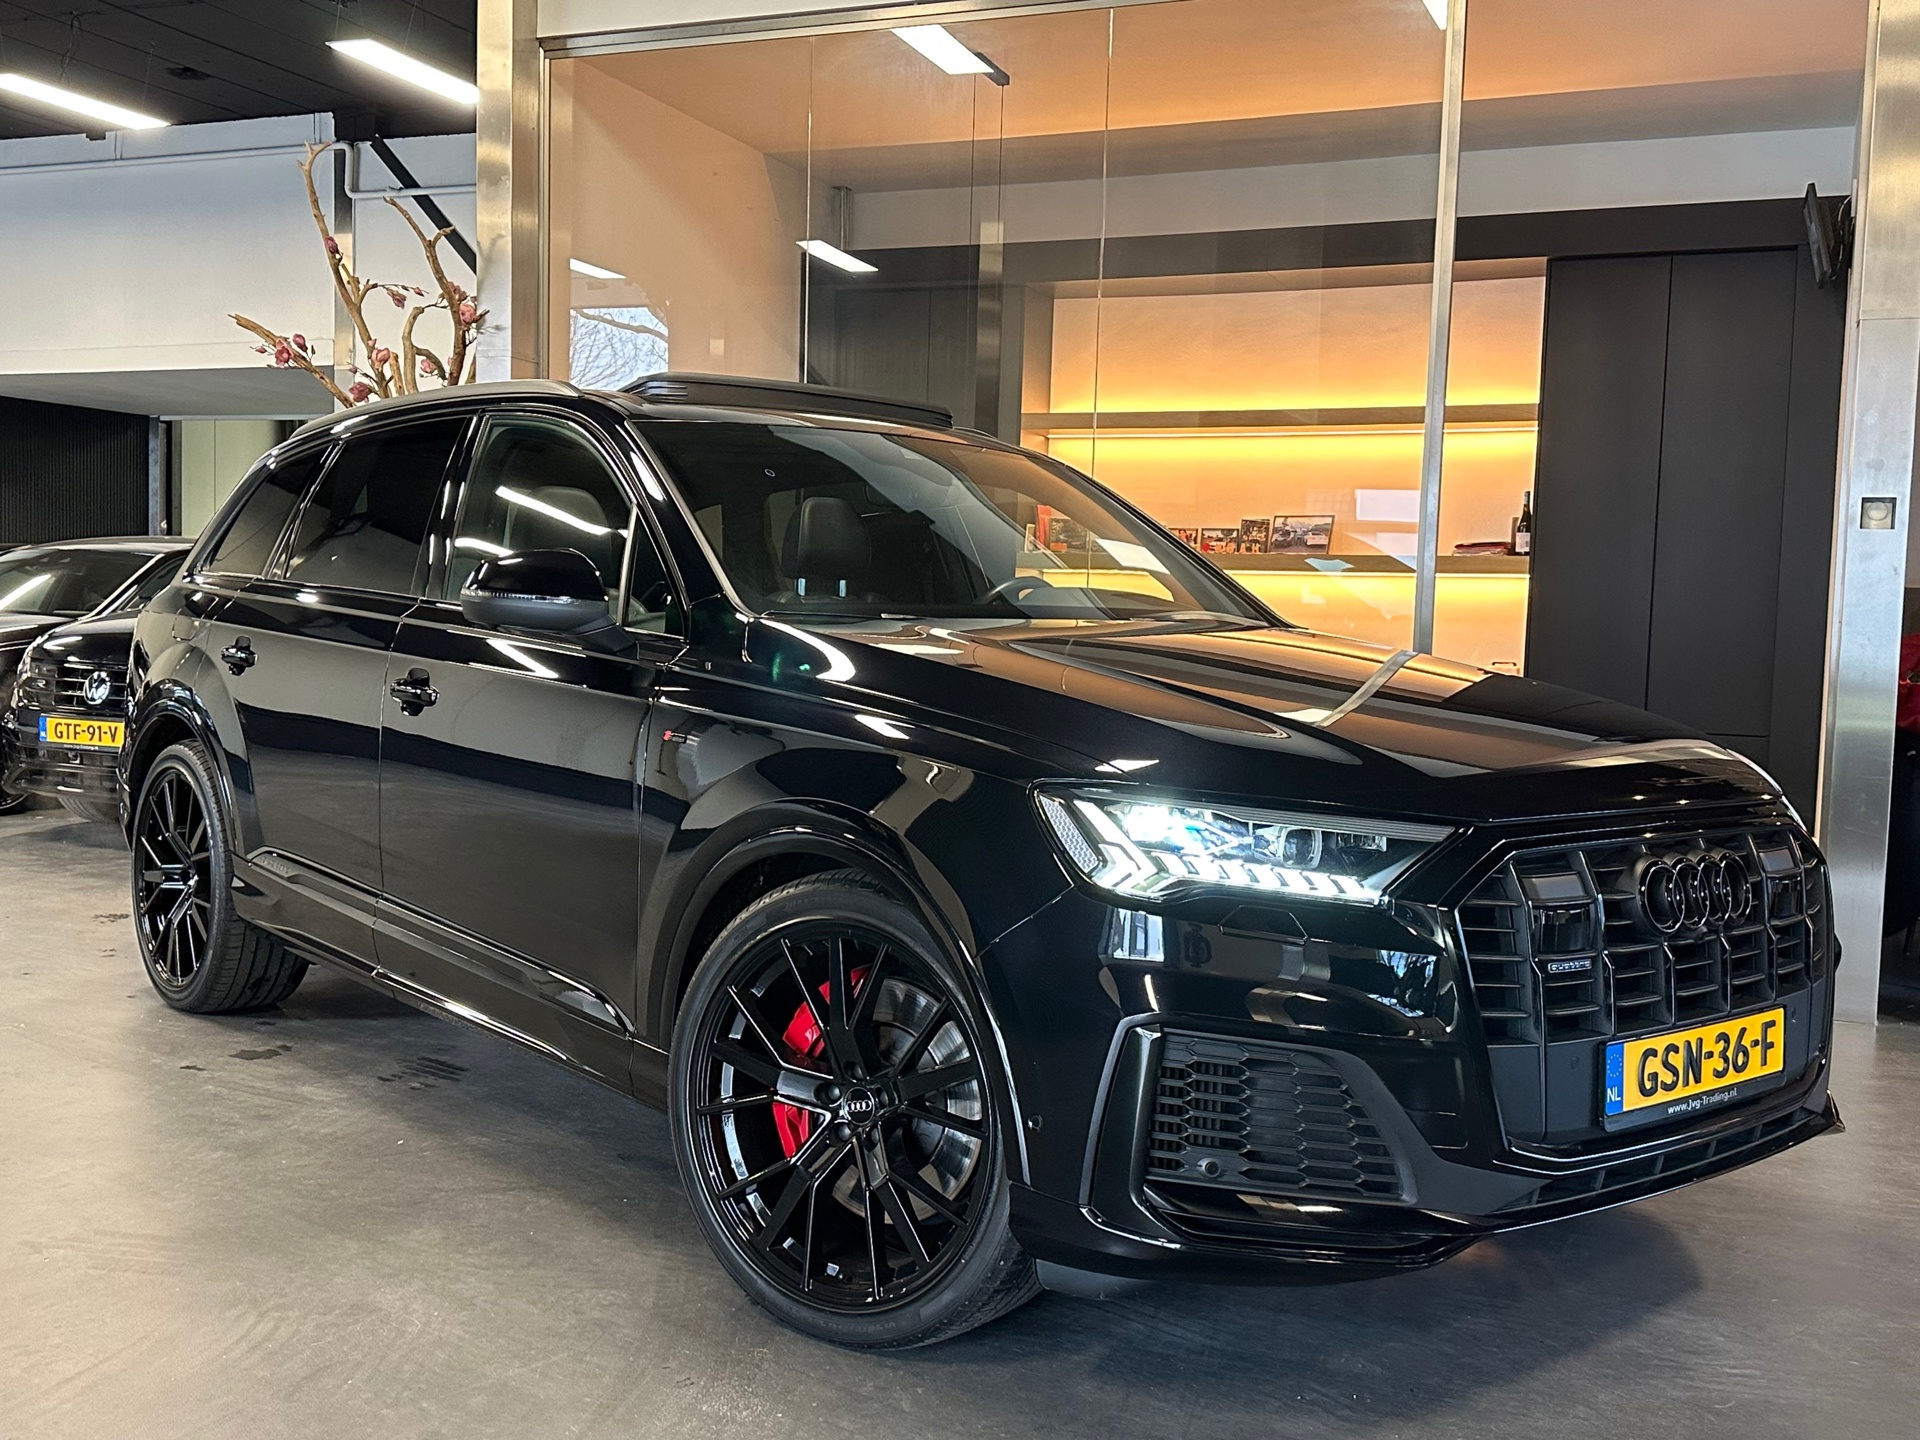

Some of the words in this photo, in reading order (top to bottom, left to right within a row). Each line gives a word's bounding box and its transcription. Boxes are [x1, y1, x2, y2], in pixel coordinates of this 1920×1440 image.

[54, 722, 118, 743] GTF-91-V
[1638, 1020, 1776, 1097] GSN-36-F
[1607, 1087, 1621, 1103] NL
